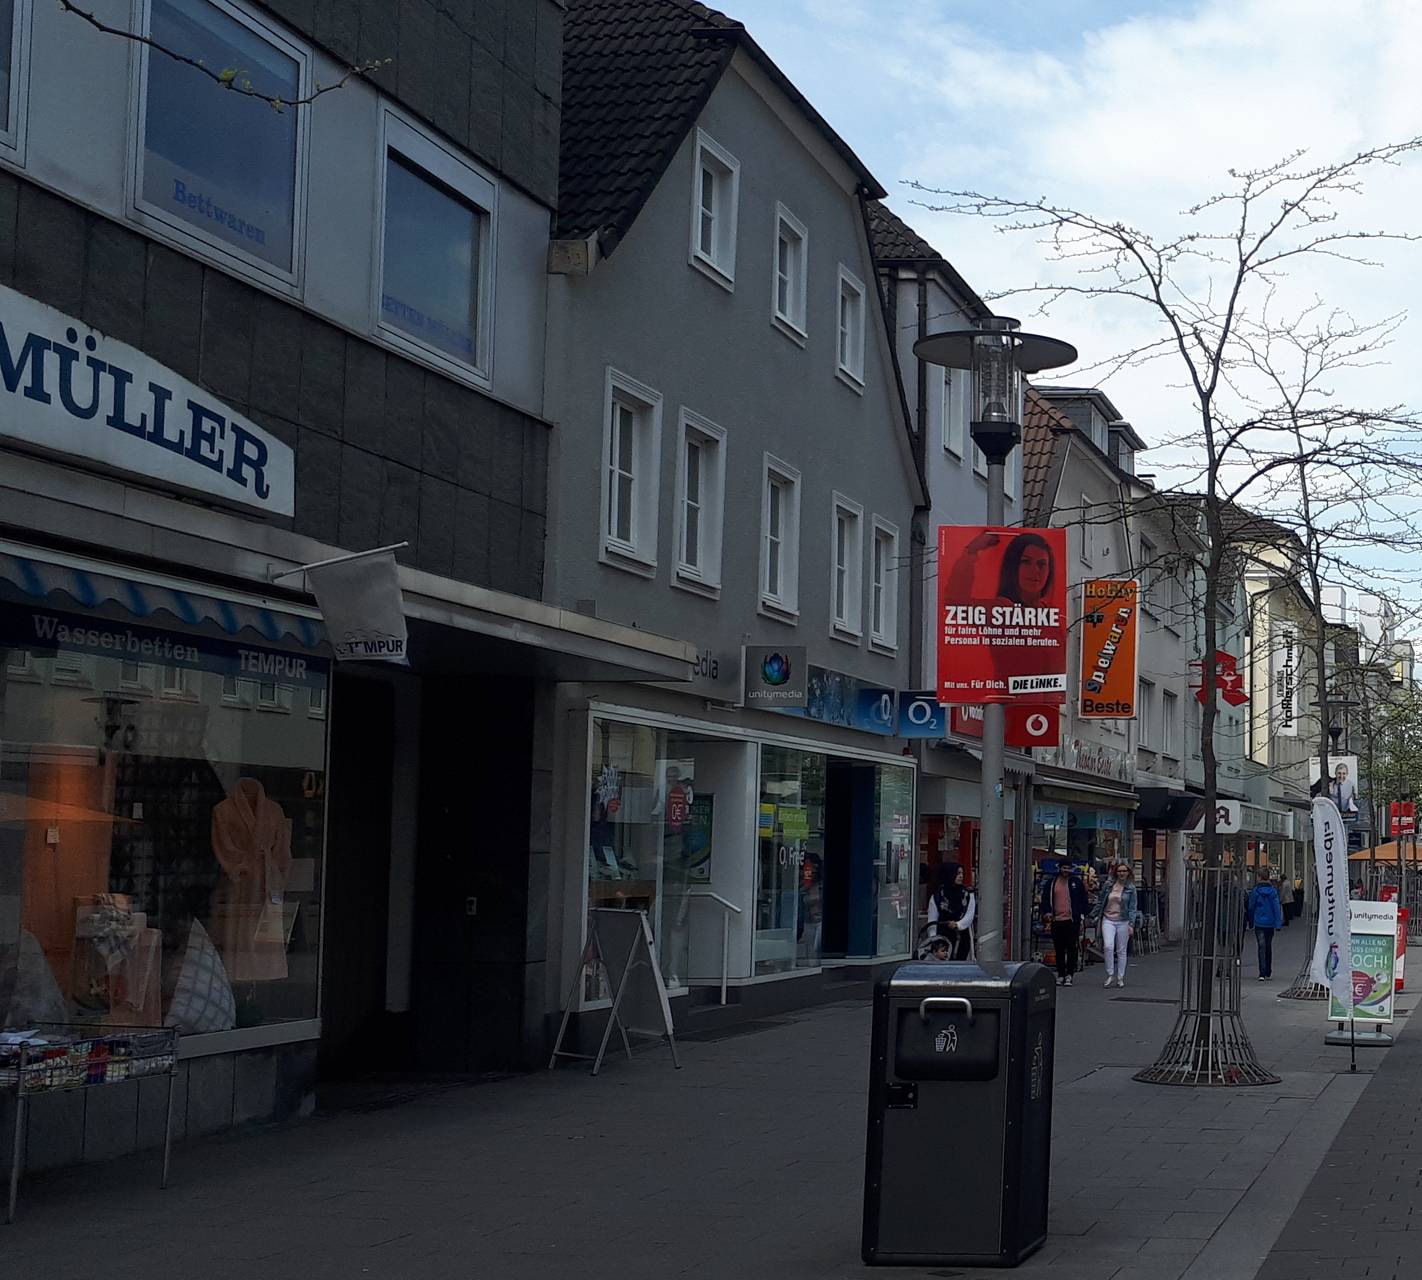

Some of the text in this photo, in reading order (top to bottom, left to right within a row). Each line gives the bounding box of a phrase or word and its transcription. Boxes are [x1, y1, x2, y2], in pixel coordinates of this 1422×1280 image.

[174, 179, 265, 247] Bettwaren
[0, 321, 270, 499] MÜLLER
[1086, 582, 1135, 601] Hobby
[945, 603, 1060, 626] ZEIG STÄRKE
[32, 613, 201, 663] Wasserbetten
[944, 626, 1042, 636] für faire Löhne und mehr
[944, 636, 1060, 647] Personal in sozialen Berufen.
[1085, 606, 1132, 694] Spielwaren
[237, 650, 307, 680] TEMPUR
[970, 680, 985, 689] Für
[985, 681, 1007, 689] Dich.
[1012, 679, 1029, 690] DIE
[748, 689, 803, 700] unitymedia
[1083, 699, 1132, 713] Beste
[1353, 911, 1394, 922] unitymedia
